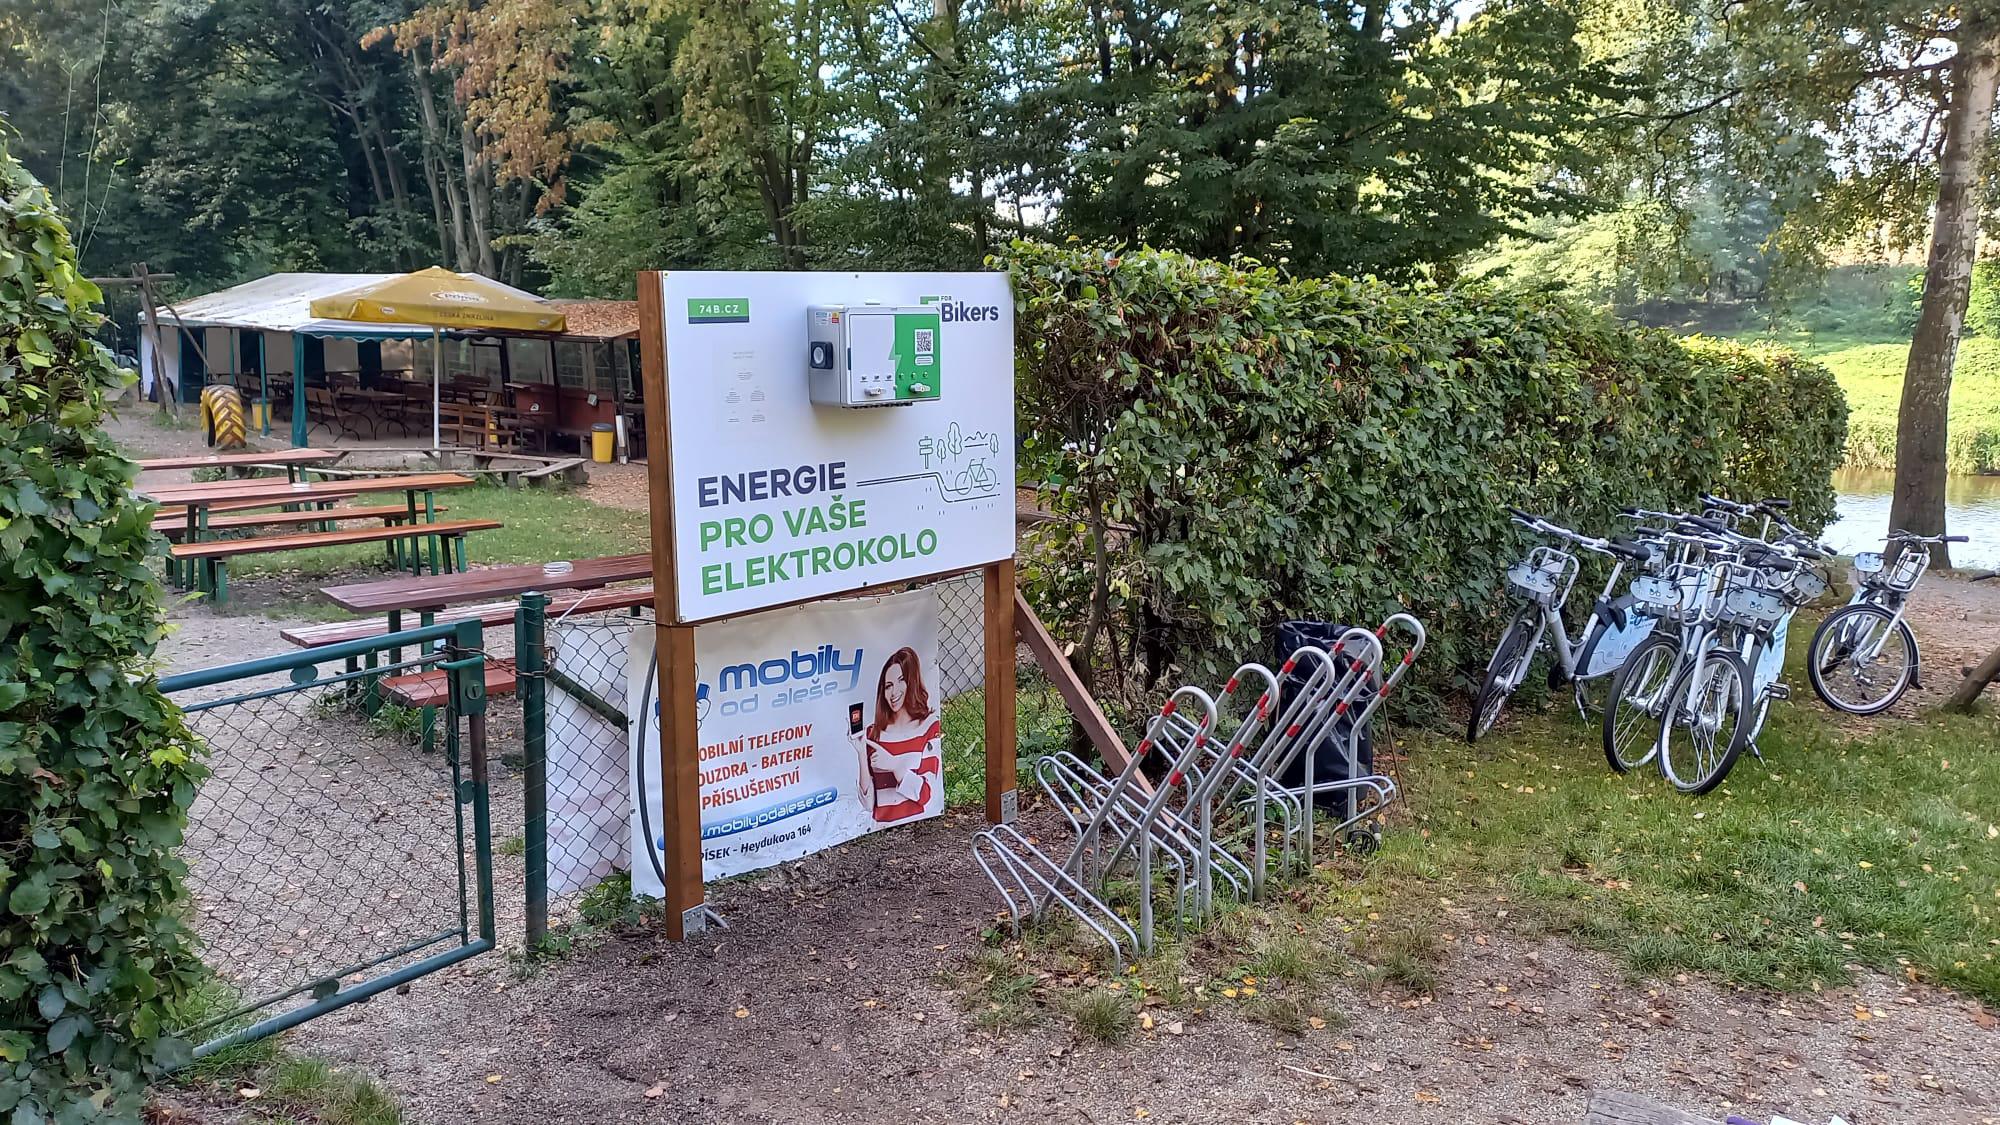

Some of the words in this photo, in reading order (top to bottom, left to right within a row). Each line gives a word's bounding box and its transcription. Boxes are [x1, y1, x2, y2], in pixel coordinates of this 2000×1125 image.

[698, 303, 740, 315] 74B.CZ
[941, 301, 999, 322] Bikers
[698, 461, 846, 507] ENERGIE
[700, 513, 774, 552] PRO
[783, 494, 866, 537] VAŠE
[702, 528, 938, 595] ELEKTROKOLO
[719, 644, 864, 693] mobily
[720, 693, 759, 717] od
[771, 677, 838, 708] aleše
[698, 734, 744, 761] OBILNÍ
[748, 724, 813, 750] TELEFONY
[699, 762, 749, 787] OUZDRA
[761, 745, 814, 769] BATERIE
[702, 766, 800, 810] PŘÍSLUŠENSTVÍ
[740, 830, 796, 856] Heydukova
[797, 823, 812, 837] 164
